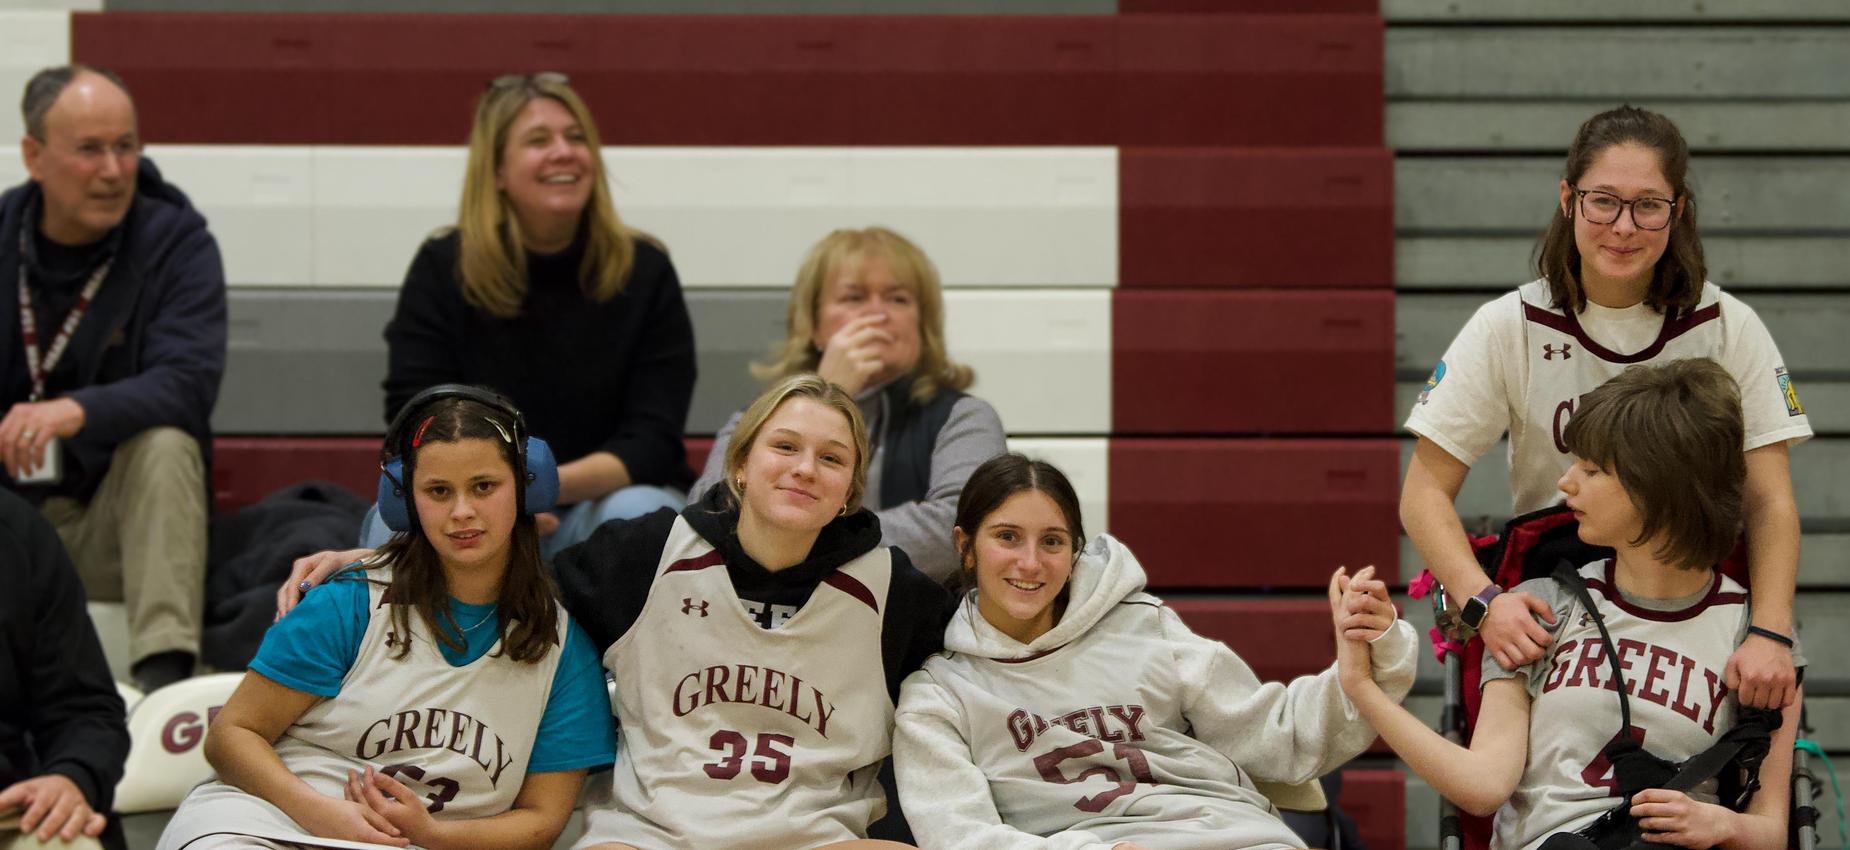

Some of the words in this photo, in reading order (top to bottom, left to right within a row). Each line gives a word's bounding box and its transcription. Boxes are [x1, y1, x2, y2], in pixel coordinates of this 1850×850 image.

[672, 664, 835, 740] GREELY
[1543, 637, 1728, 736] GREELY
[356, 708, 513, 790] GREELY
[703, 730, 794, 784] 35
[1033, 738, 1159, 812] 51
